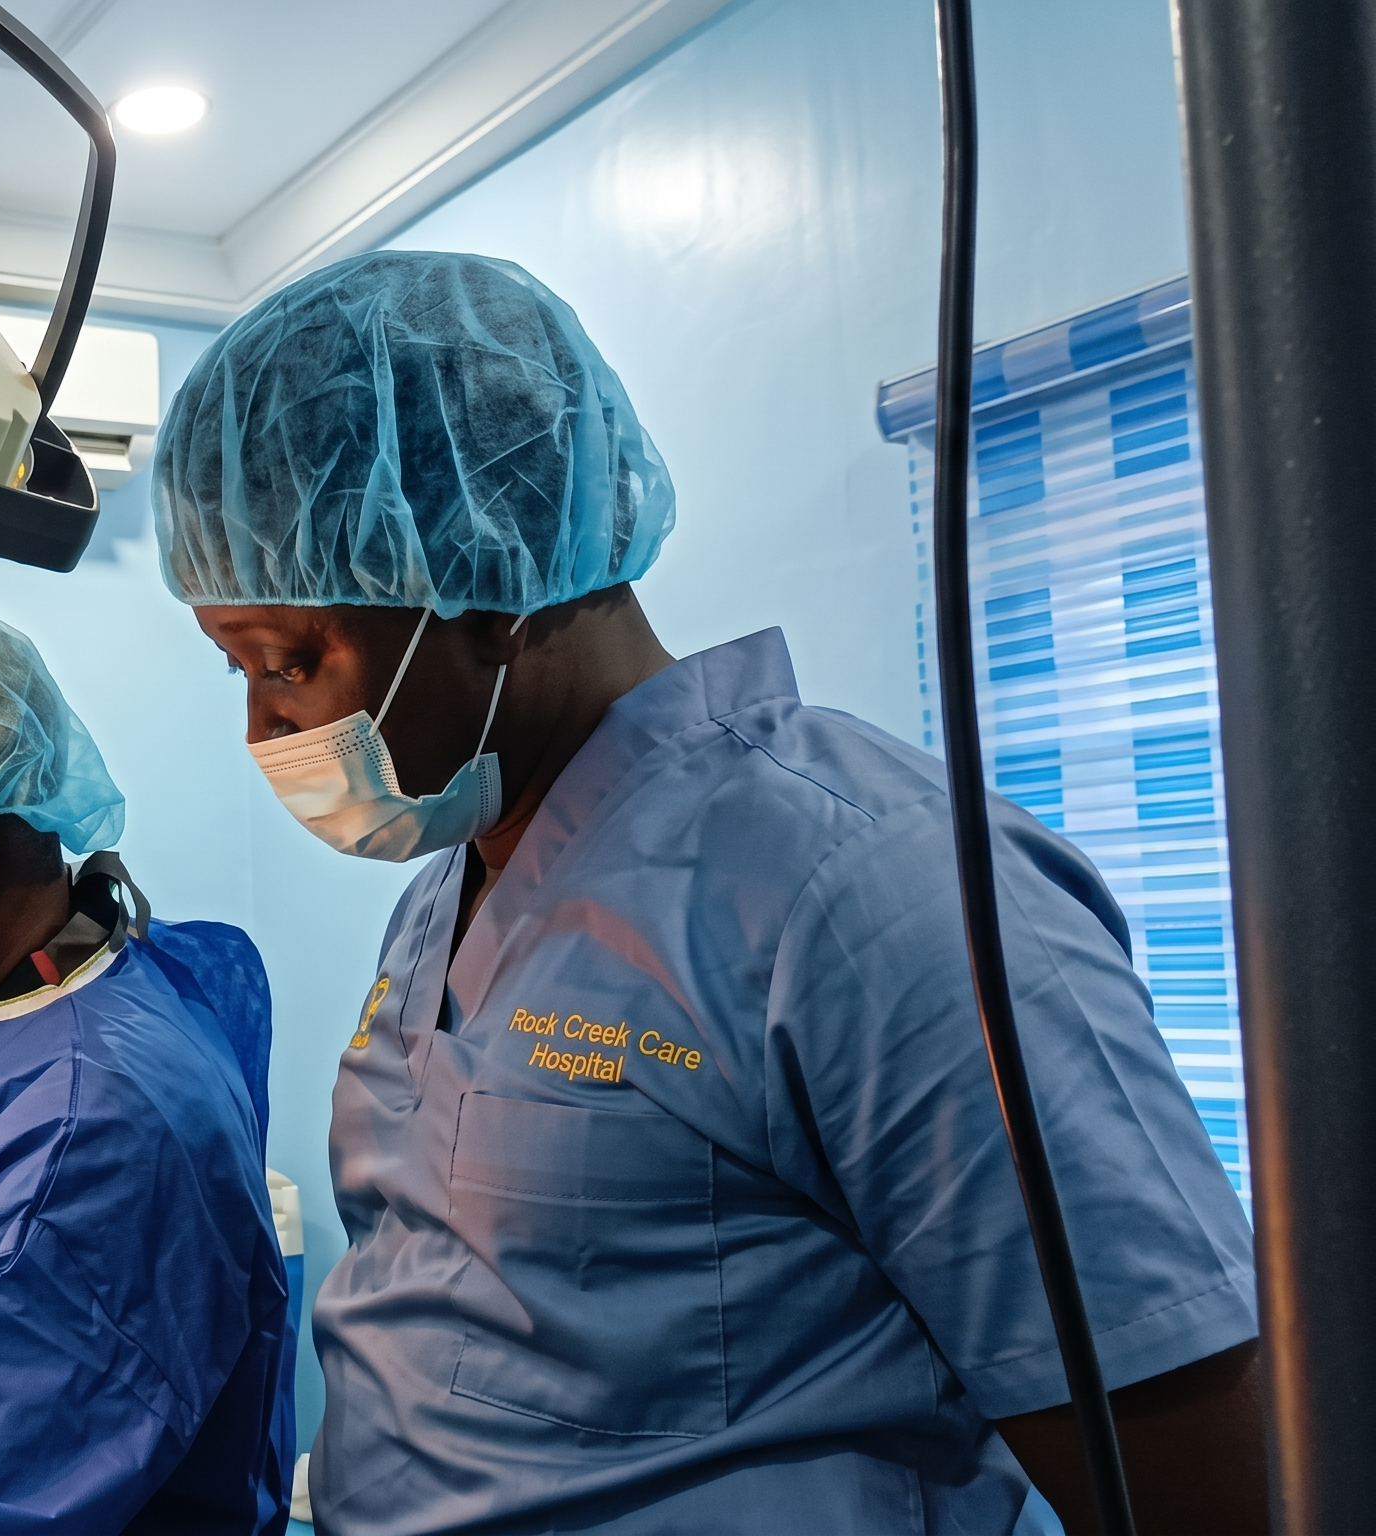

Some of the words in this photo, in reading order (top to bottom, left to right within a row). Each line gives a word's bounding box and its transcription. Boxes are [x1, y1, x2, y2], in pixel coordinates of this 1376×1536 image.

[508, 1008, 560, 1036] Rock
[563, 1014, 632, 1048] Creek
[638, 1030, 702, 1070] Care
[528, 1042, 624, 1083] Hospital
